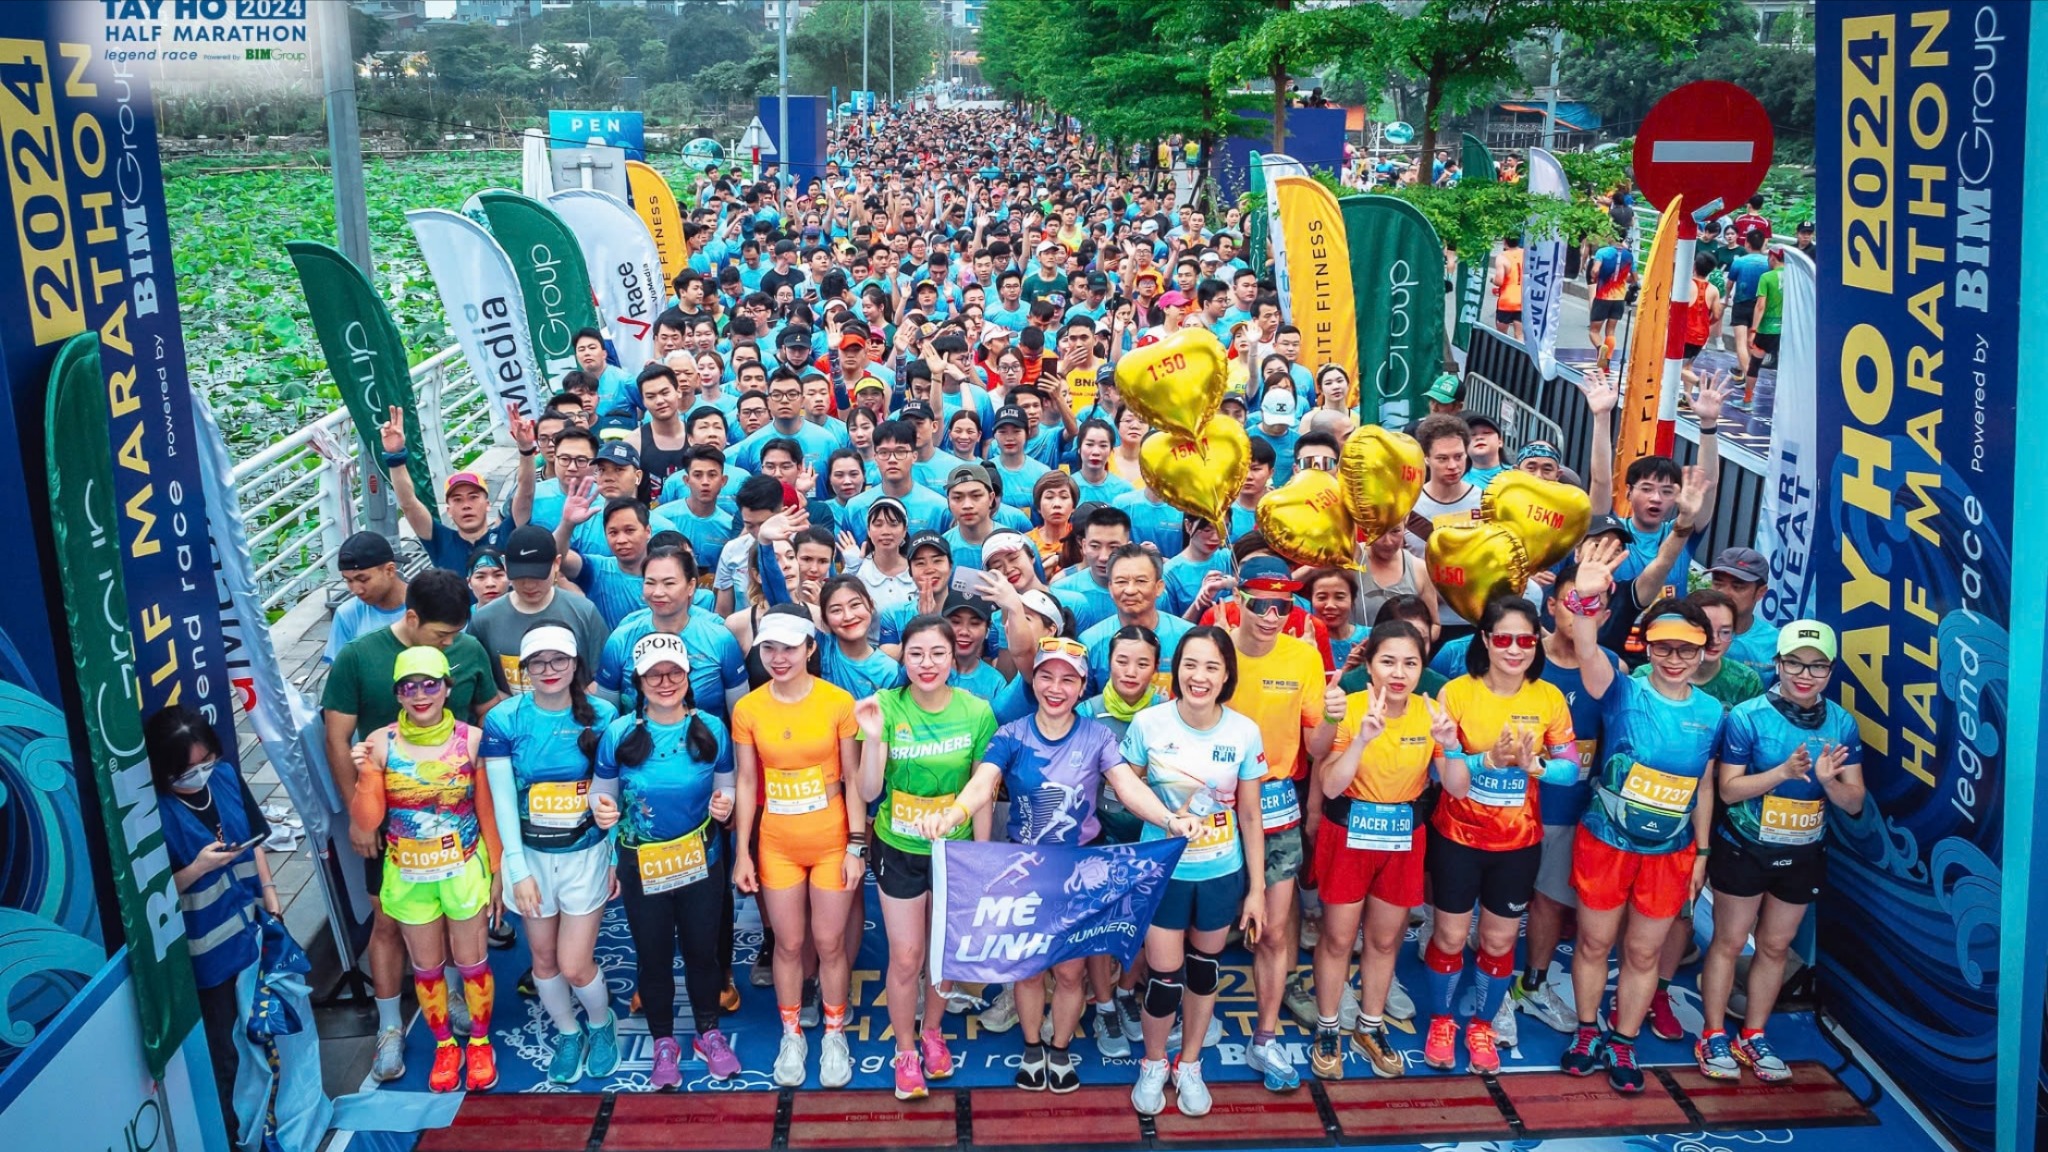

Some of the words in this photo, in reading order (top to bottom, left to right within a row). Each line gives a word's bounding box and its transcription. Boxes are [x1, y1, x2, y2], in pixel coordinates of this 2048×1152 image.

[571, 118, 621, 133] PEN
[1846, 30, 1889, 272] 2024
[0, 54, 79, 320] 2024
[1954, 5, 2006, 313] BIMGroup
[650, 195, 670, 265] FITNESS
[618, 262, 648, 318] Race
[1309, 219, 1332, 311] FITNESS
[1905, 9, 1950, 548] MARATHON
[59, 42, 162, 558] MARATHON
[154, 333, 165, 361] by
[1146, 352, 1187, 383] 1:50
[1973, 333, 1989, 364] by
[159, 367, 177, 458] Powered
[1840, 322, 1895, 521] HO
[1971, 370, 1986, 473] Powered
[1304, 487, 1339, 514] 1:50
[1526, 503, 1565, 530] 15KM
[167, 479, 196, 593] race
[1960, 494, 1983, 625] race
[1841, 531, 1891, 757] TAY
[1901, 577, 1940, 789] HALF
[1951, 636, 1984, 824] legend
[768, 779, 822, 798] C11152
[1502, 777, 1525, 791] 1:50
[1628, 774, 1691, 803] C11737
[1351, 815, 1388, 832] PACER
[1392, 816, 1411, 832] 1:50
[401, 847, 460, 867] C10996
[643, 849, 702, 876] C11143
[972, 890, 1043, 928] MÊ
[1066, 921, 1138, 946] RUNNERS
[955, 933, 1054, 963] LINH
